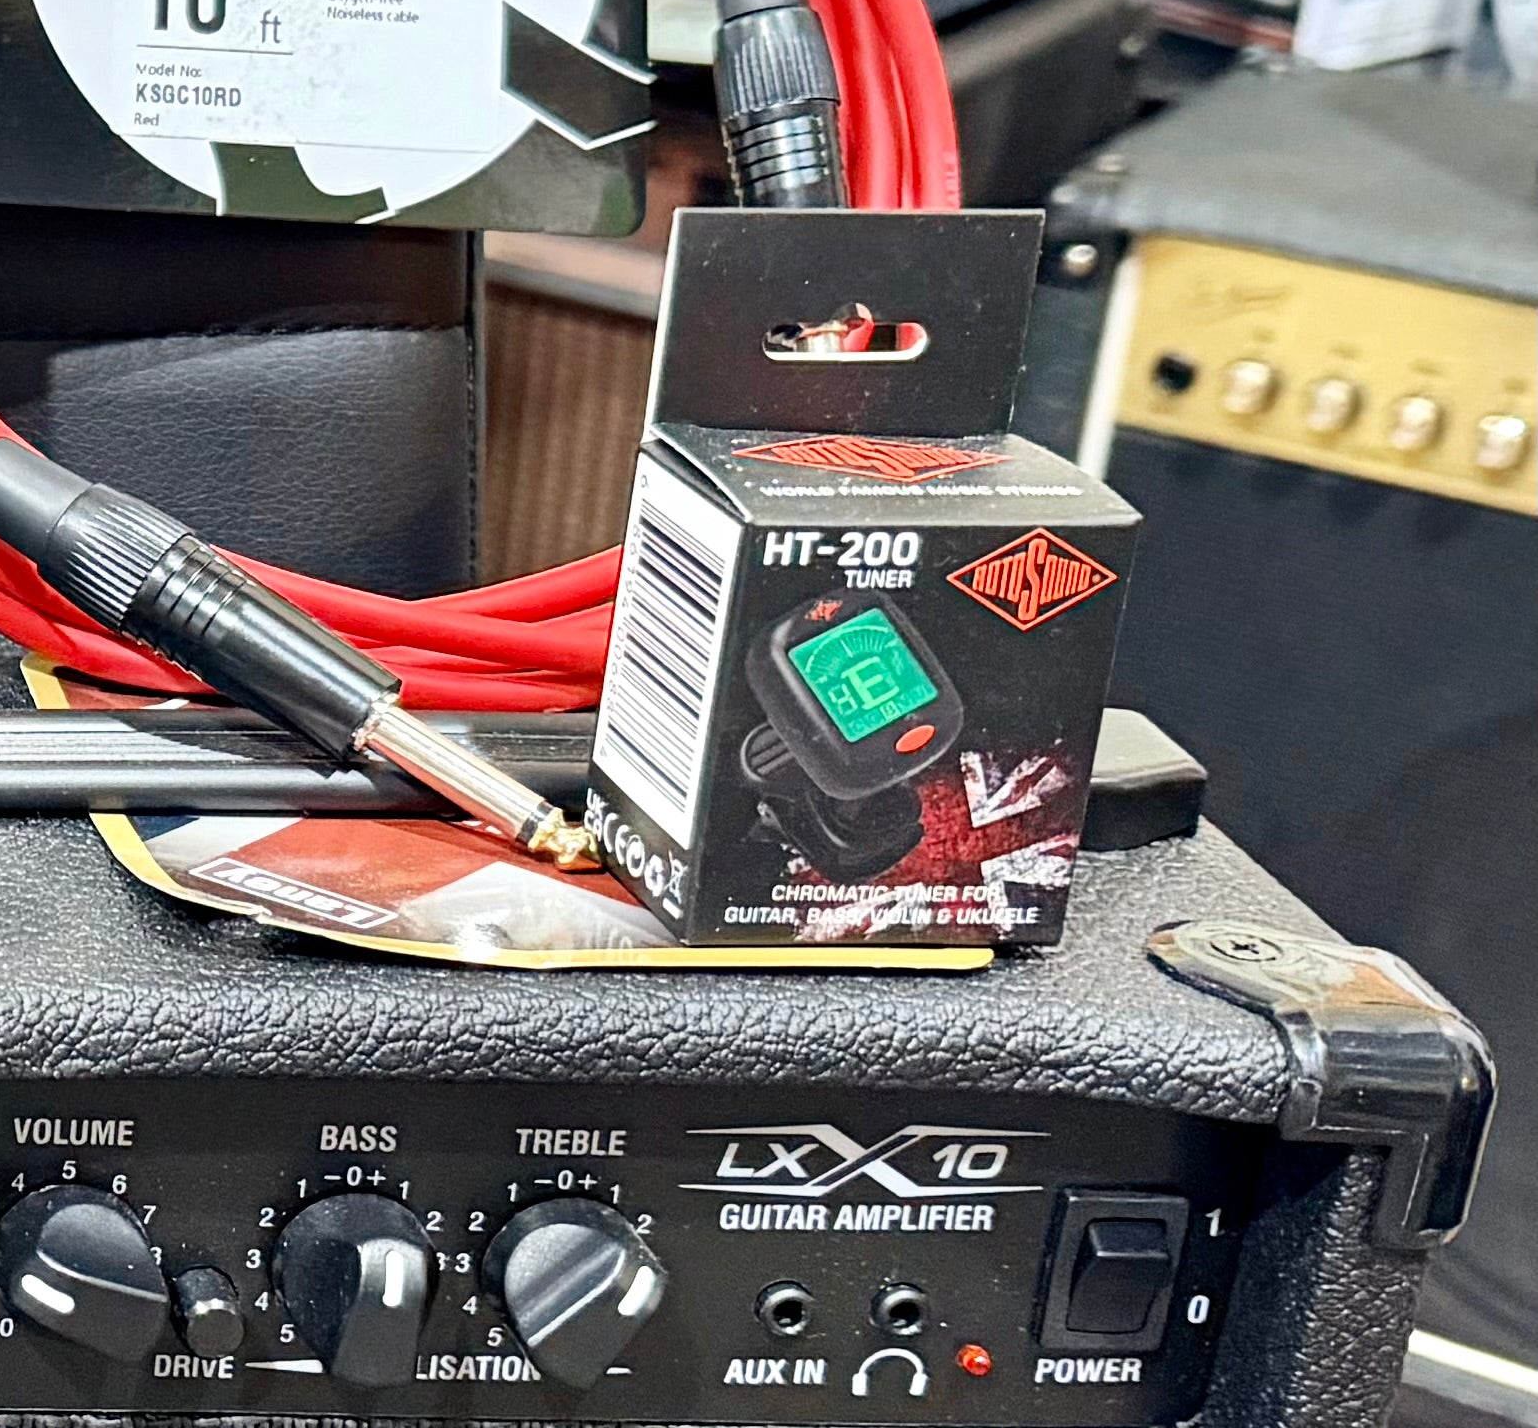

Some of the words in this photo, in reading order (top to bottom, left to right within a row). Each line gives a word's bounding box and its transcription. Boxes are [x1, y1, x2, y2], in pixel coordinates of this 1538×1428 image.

[260, 9, 282, 44] ft
[386, 10, 420, 23] cable
[135, 83, 242, 107] KSGC10RD
[134, 112, 160, 127] Red
[763, 531, 920, 567] HT-200
[844, 569, 913, 589] TUNER
[212, 867, 374, 926] Laney
[771, 884, 889, 902] CHROMATIC
[893, 884, 956, 902] TUNER
[961, 885, 1000, 902] FOR
[724, 906, 800, 925] GUITAR,
[956, 906, 1038, 925] UKULELE
[14, 1118, 135, 1147] VOLUME
[320, 1125, 398, 1153] BASS
[516, 1128, 626, 1157] TREBLE
[62, 1160, 77, 1180] 5
[11, 1172, 25, 1192] 4
[112, 1174, 128, 1194] 6
[297, 1178, 307, 1199] 1
[399, 1180, 410, 1200] 1
[507, 1182, 518, 1202] 1
[609, 1184, 621, 1204] 1
[142, 1205, 157, 1225] 7
[259, 1208, 275, 1228] 2
[427, 1211, 443, 1232] 2
[469, 1212, 485, 1232] 2
[637, 1214, 653, 1234] 2
[719, 1203, 827, 1231] GUITAR
[834, 1203, 995, 1232] AMPLIFIER
[1205, 1208, 1225, 1238] 1
[245, 1249, 262, 1269] 3
[455, 1253, 471, 1273] 3
[255, 1291, 271, 1311] 4
[462, 1296, 478, 1315] 4
[1187, 1294, 1211, 1325] 0
[0, 1317, 14, 1338] 0
[280, 1324, 295, 1344] 5
[487, 1327, 503, 1347] 5
[153, 1353, 234, 1379] DRIVE
[724, 1358, 789, 1384] AUX
[792, 1358, 826, 1384] IN
[1034, 1357, 1142, 1384] POWER
